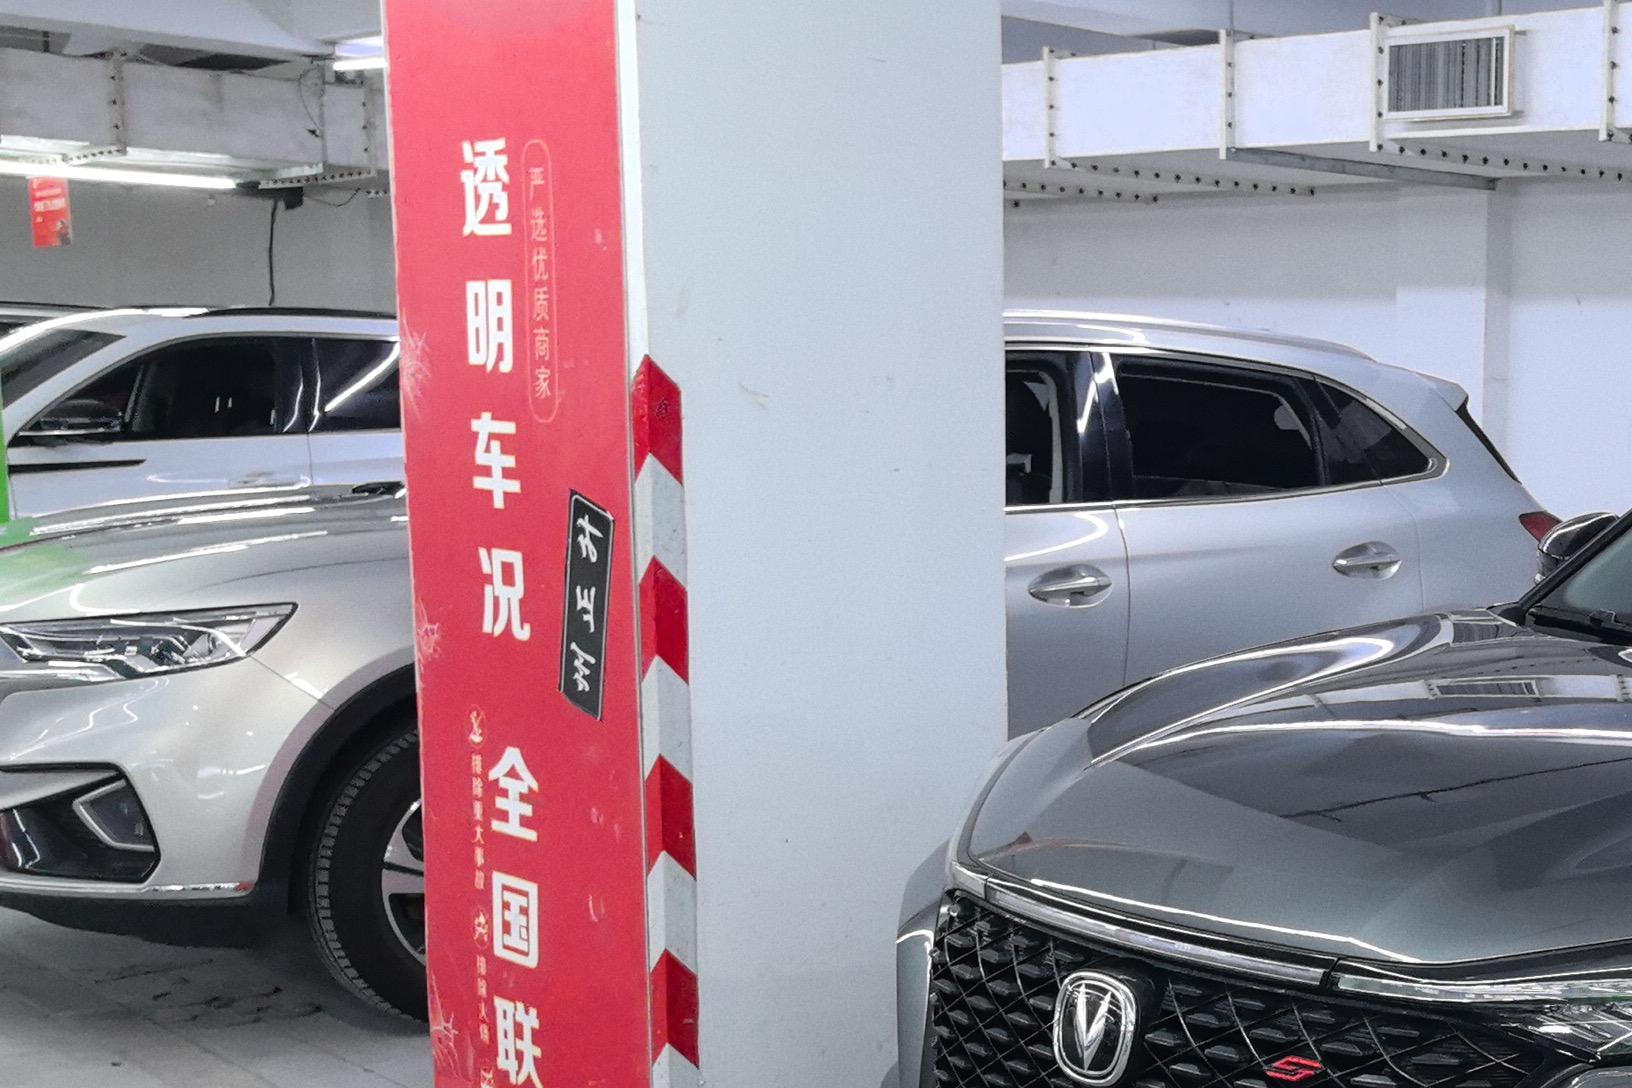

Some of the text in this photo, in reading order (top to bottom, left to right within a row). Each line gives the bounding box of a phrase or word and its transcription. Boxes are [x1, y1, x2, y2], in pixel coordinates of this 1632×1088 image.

[461, 138, 531, 640] 透明车况
[528, 166, 551, 399] 严选优质商家
